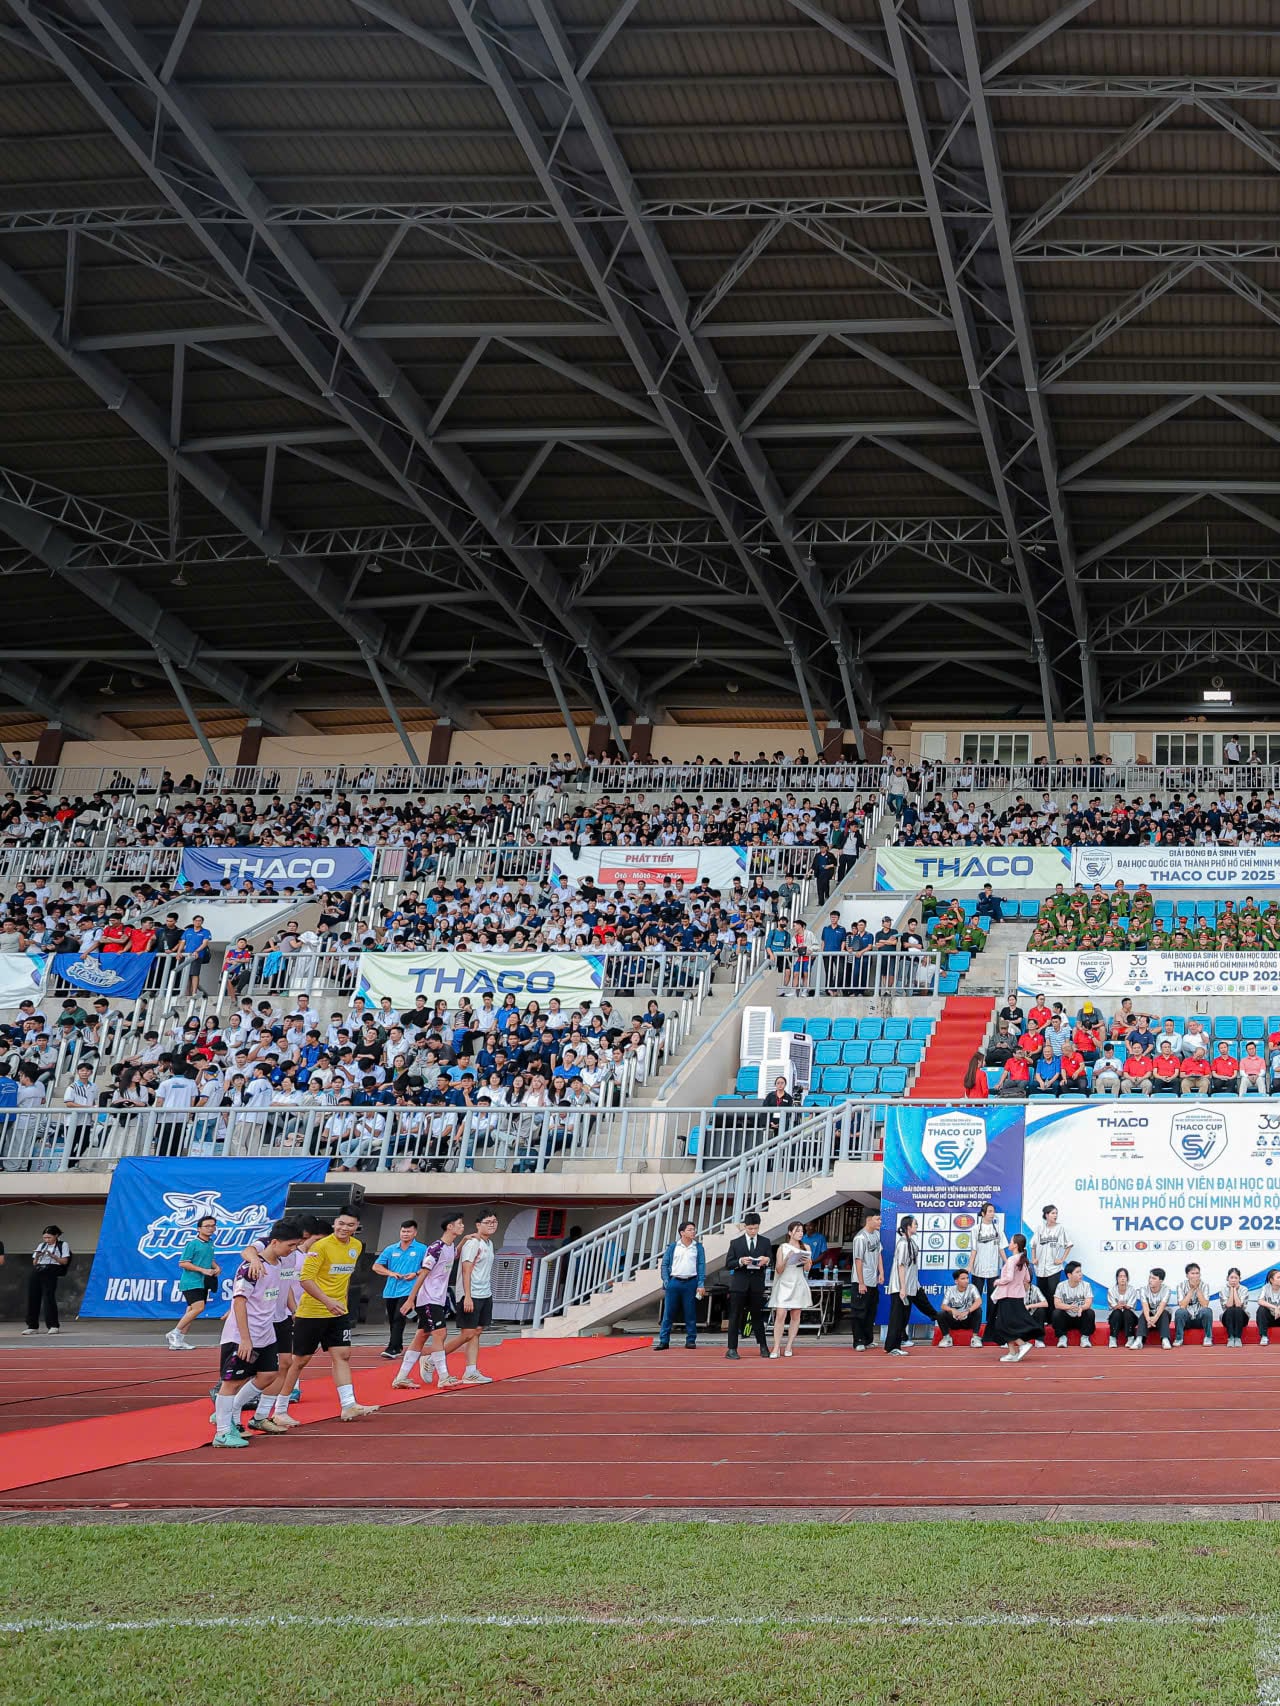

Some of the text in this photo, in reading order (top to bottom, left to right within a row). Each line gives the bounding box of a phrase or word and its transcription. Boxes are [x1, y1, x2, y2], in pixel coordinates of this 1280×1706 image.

[625, 853, 674, 862] PHÁT TIẾN
[1117, 858, 1132, 868] ĐẠI
[1133, 858, 1147, 868] HỌC
[1148, 858, 1168, 868] QUỐC
[1169, 858, 1182, 868] GIA
[1183, 858, 1209, 868] THÀNH
[1210, 858, 1226, 868] PHỐ
[1227, 858, 1240, 868] HỒ
[1241, 858, 1252, 868] CHÍ
[1253, 858, 1273, 868] MINH
[216, 858, 335, 879] THACO
[914, 856, 1033, 877] THACO
[1151, 871, 1275, 881] THACO CUP 2025
[407, 968, 556, 993] THACO
[1164, 971, 1214, 981] THACO
[1219, 971, 1249, 981] CUP
[1097, 1118, 1148, 1127] THACO
[1075, 1175, 1099, 1190] GIẢI
[1101, 1175, 1134, 1190] BÓNG
[1136, 1175, 1152, 1190] ĐÁ
[1155, 1178, 1183, 1190] SINH
[1187, 1175, 1214, 1190] VIÊN
[1217, 1177, 1237, 1192] ĐẠI
[1239, 1177, 1264, 1192] HỌC
[1098, 1193, 1139, 1208] THÀNH
[1142, 1192, 1166, 1208] PHỐ
[1169, 1192, 1186, 1208] HỒ
[1188, 1193, 1208, 1208] CHÍ
[1211, 1196, 1240, 1208] MINH
[1243, 1194, 1261, 1208] MỞ
[1112, 1215, 1184, 1231] THACO
[1190, 1215, 1233, 1231] CUP
[148, 1226, 266, 1248] HCUT
[926, 1255, 944, 1263] UEH
[104, 1278, 170, 1301] HCMUT
